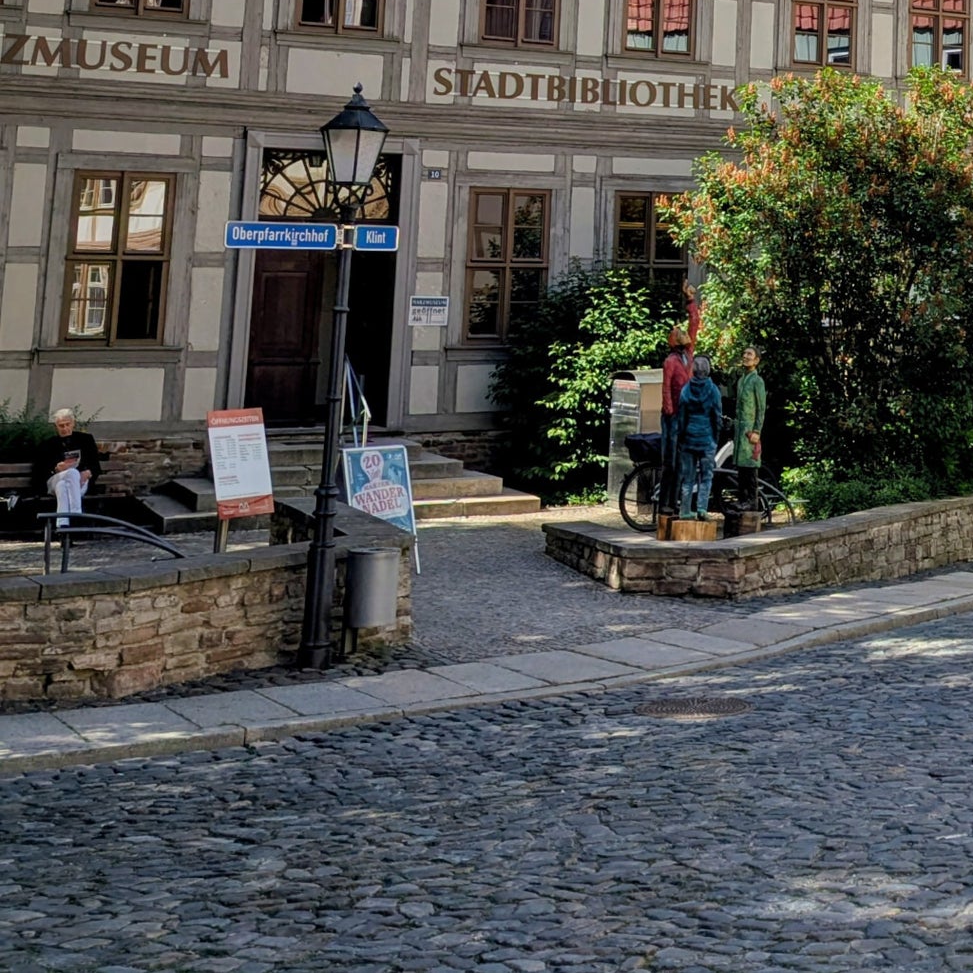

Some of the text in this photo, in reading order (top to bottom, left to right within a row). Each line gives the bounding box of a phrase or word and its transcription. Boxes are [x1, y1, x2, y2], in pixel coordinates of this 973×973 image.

[1, 33, 229, 79] ZMUSEUM
[433, 67, 740, 112] STADTBIBLIOTHEK
[431, 170, 440, 179] 10
[232, 226, 329, 244] Oberpfarrkirchhof
[366, 230, 386, 244] Klint
[412, 307, 446, 324] geöffnet
[363, 454, 381, 469] 20
[354, 486, 405, 506] WANDER
